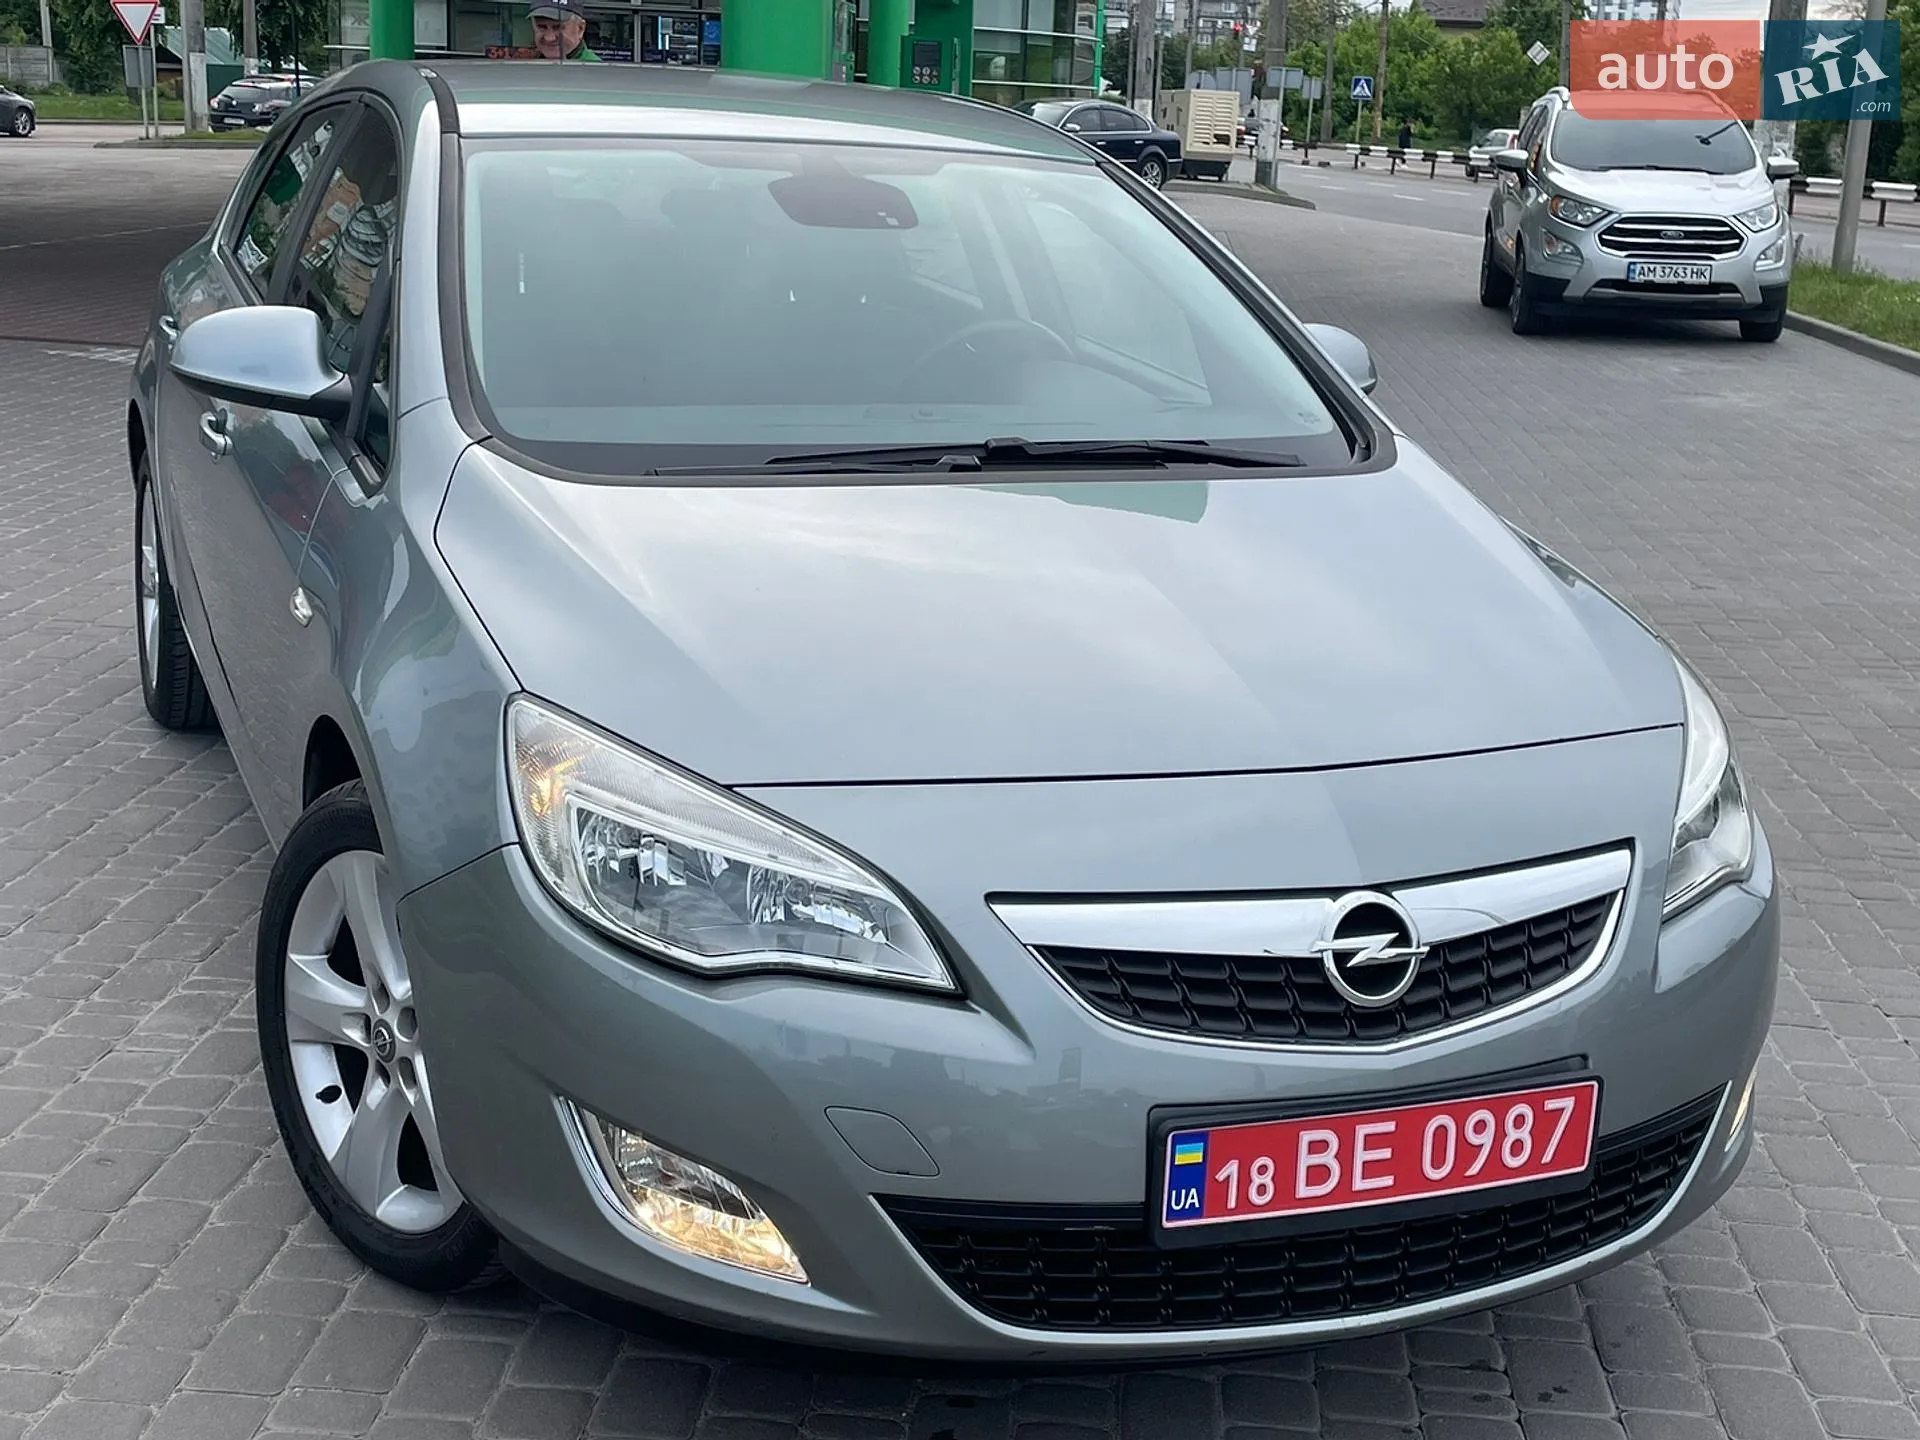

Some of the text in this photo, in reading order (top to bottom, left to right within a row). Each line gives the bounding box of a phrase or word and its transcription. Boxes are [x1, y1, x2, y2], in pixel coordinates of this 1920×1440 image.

[1638, 265, 1709, 280] AM 3763 HK
[1213, 1095, 1577, 1210] 18 BE 0987
[1171, 1187, 1200, 1211] UA
